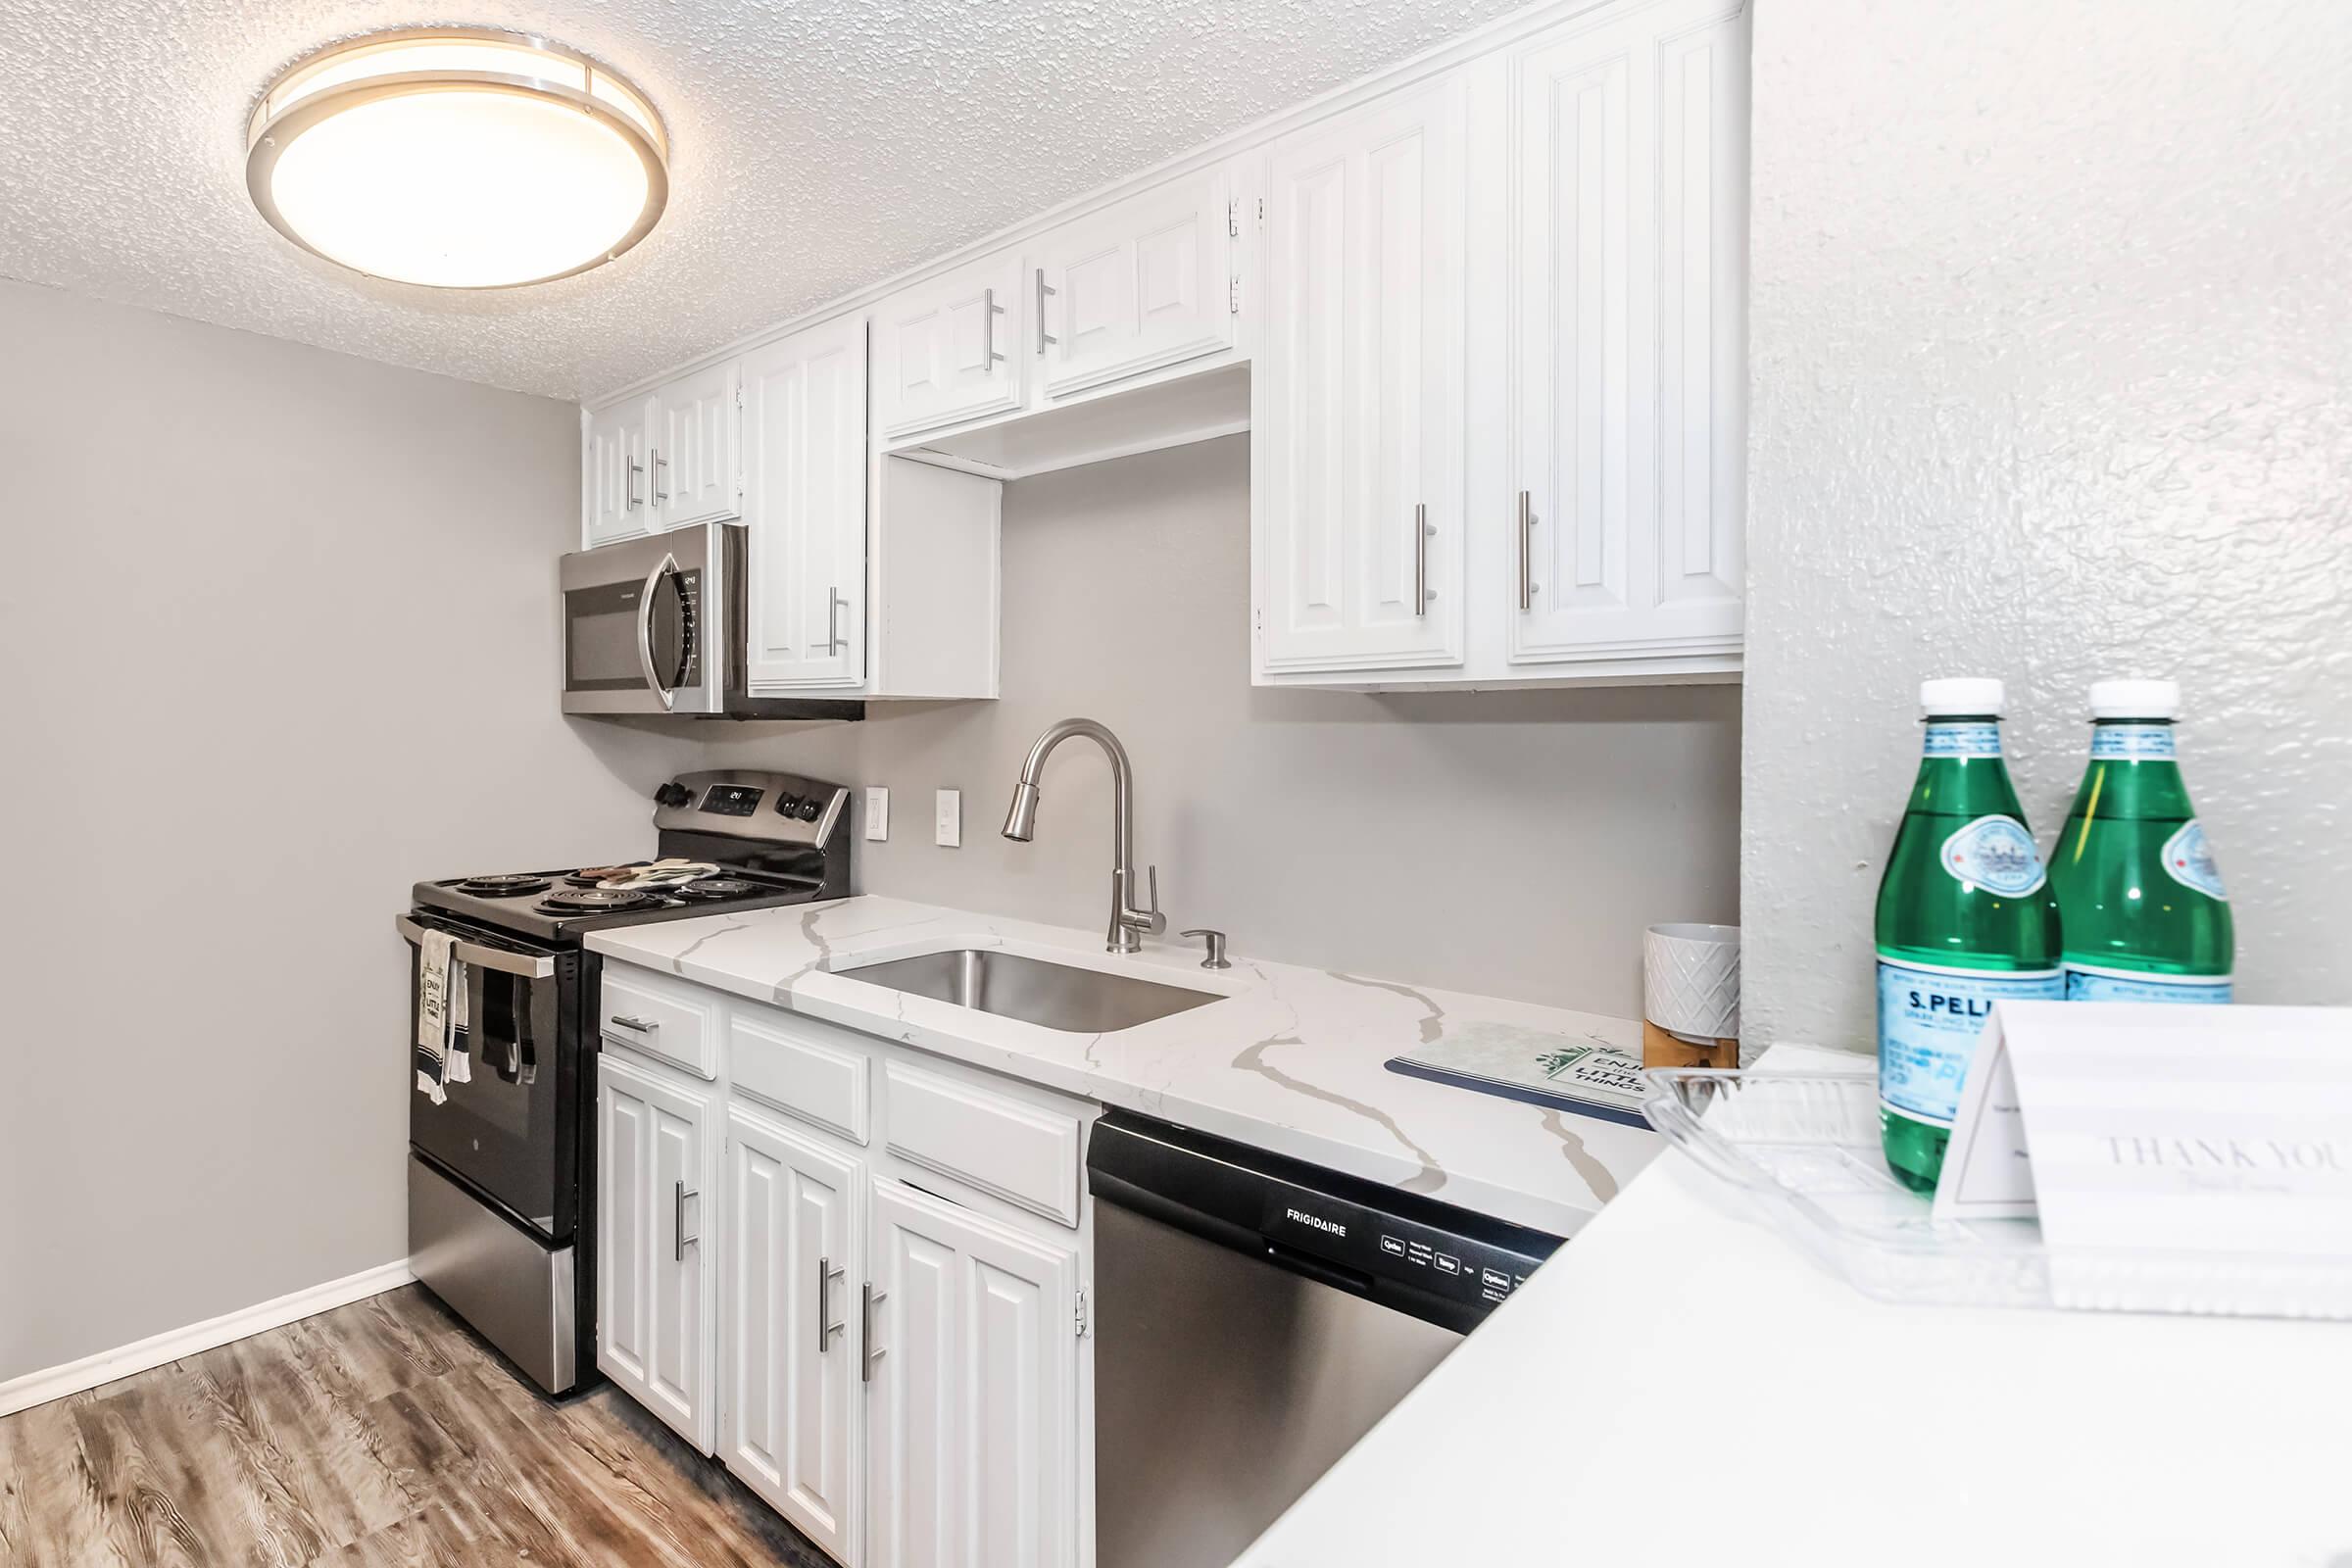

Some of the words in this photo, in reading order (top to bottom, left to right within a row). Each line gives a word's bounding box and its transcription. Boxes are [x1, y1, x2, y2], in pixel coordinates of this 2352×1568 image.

[1576, 1067, 1645, 1086] LITTL
[1576, 1074, 1645, 1092] THINGS
[2109, 1136, 2257, 1168] THANK
[1287, 1208, 1347, 1237] FRIGIDAIRE
